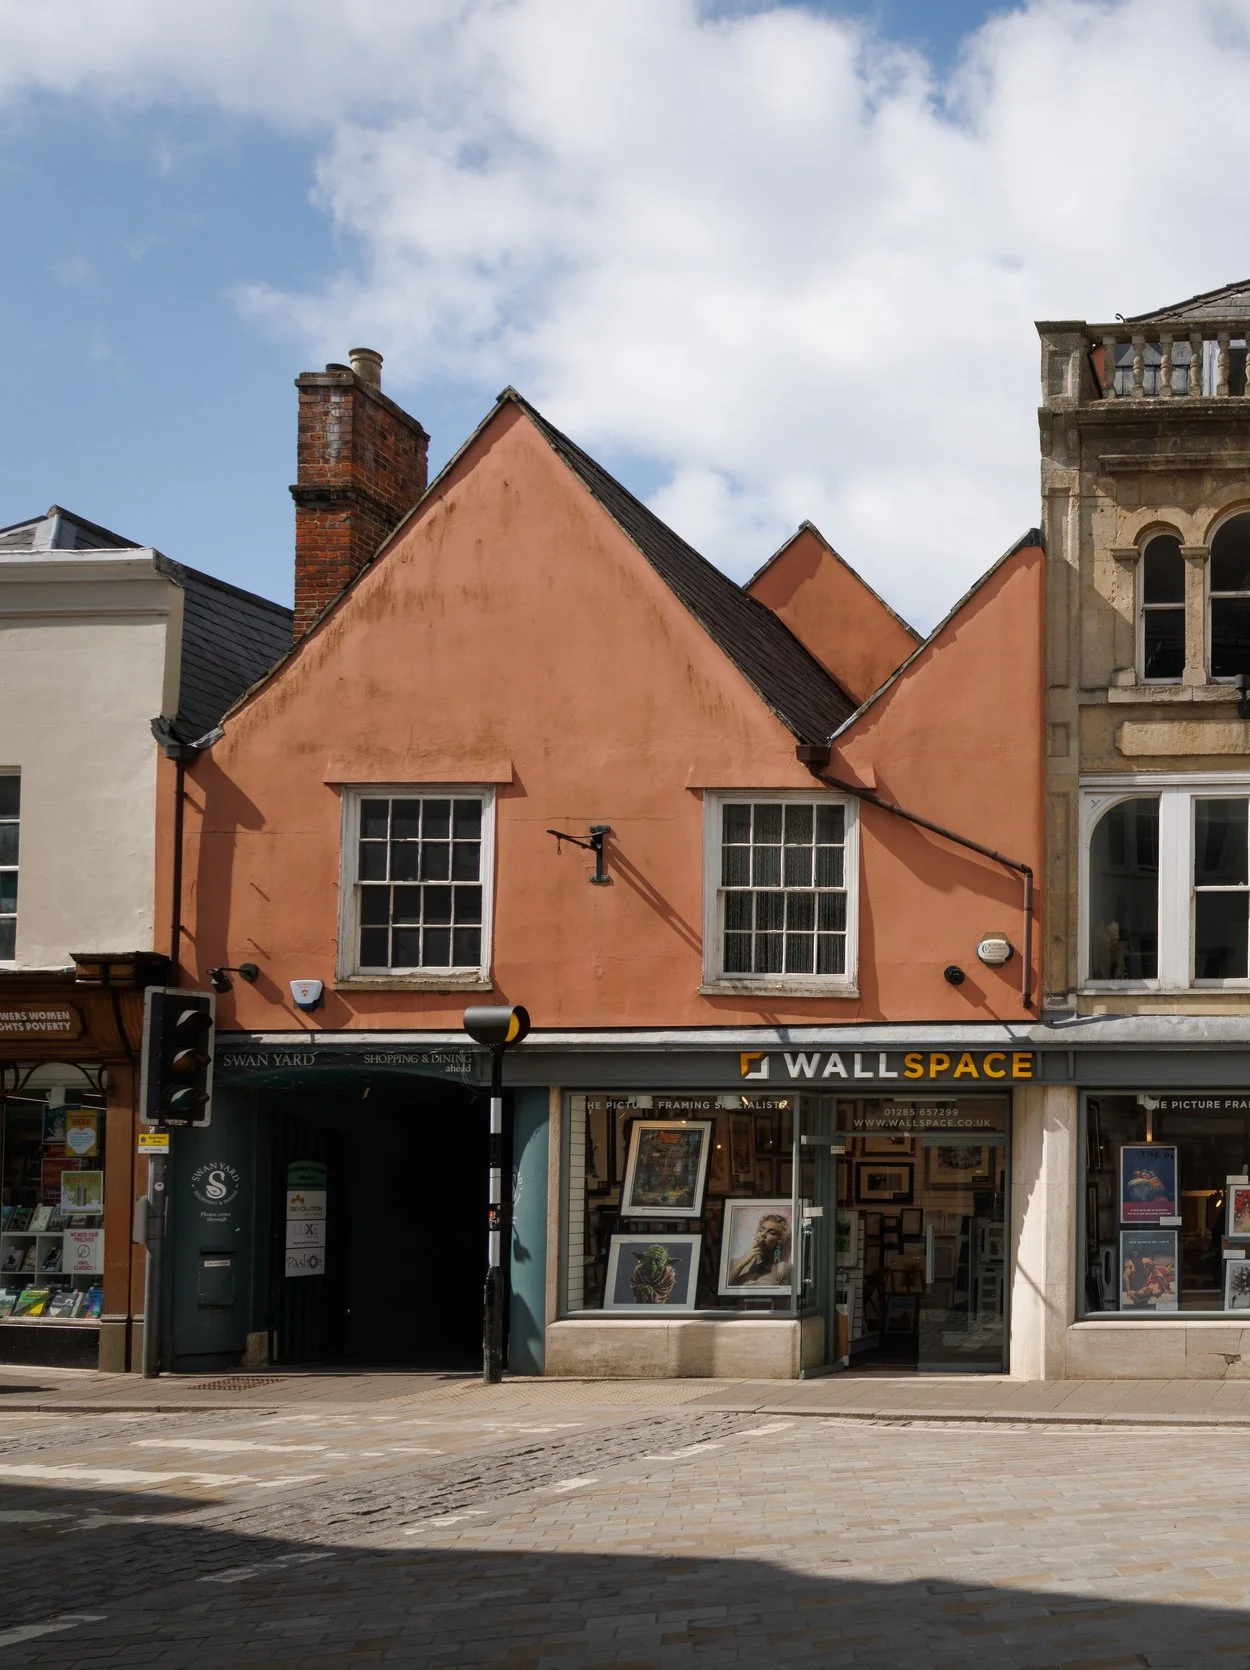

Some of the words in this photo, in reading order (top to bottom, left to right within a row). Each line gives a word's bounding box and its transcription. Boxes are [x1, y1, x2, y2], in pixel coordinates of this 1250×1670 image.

[28, 1011, 71, 1020] WOMEN
[25, 1021, 71, 1031] POVERTY
[223, 1054, 269, 1067] SWAN
[272, 1053, 315, 1066] YARD
[364, 1054, 419, 1064] SHOPPING
[421, 1054, 429, 1064] &
[431, 1054, 472, 1064] DINING
[445, 1063, 472, 1073] ahead
[658, 1101, 710, 1109] FRAMING
[1171, 1101, 1221, 1109] PICTURE
[884, 1108, 915, 1116] 01285
[919, 1108, 959, 1116] 657299
[853, 1119, 991, 1127] WWW.WALLSPACE.CO.UK
[191, 1162, 218, 1182] SWAN
[219, 1162, 240, 1182] YARD
